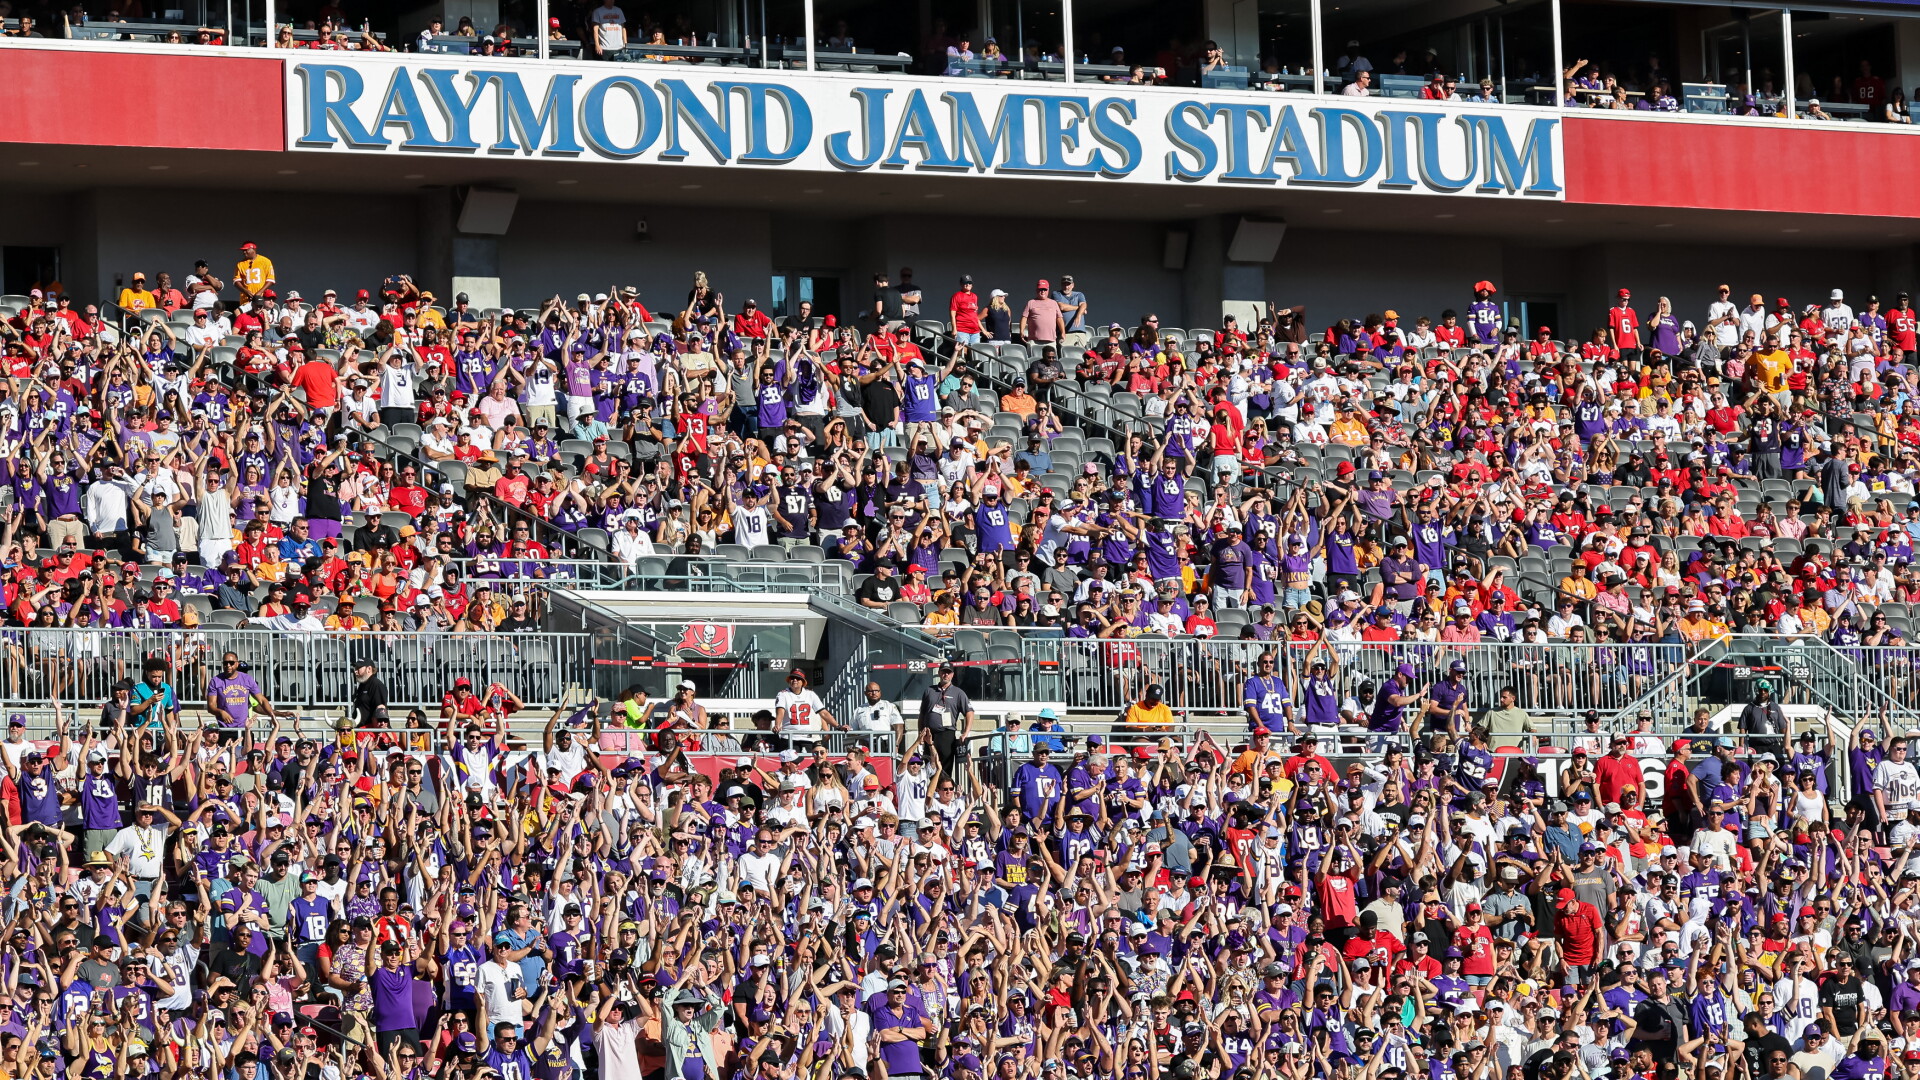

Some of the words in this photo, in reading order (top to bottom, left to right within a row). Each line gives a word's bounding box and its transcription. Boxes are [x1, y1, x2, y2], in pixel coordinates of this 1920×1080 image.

[1859, 87, 1875, 99] 82
[294, 63, 813, 164] RAYMOND
[824, 87, 1142, 178] JAMES
[1165, 101, 1563, 195] STADIUM
[246, 268, 261, 284] 13
[1478, 310, 1495, 324] 94
[1622, 318, 1632, 334] 6
[1896, 319, 1916, 332] 55
[535, 369, 550, 384] 19
[627, 380, 645, 394] 43
[915, 384, 930, 401] 18
[687, 418, 704, 436] 13
[1791, 432, 1800, 449] 9
[950, 472, 959, 481] 61
[786, 496, 806, 514] 87
[747, 516, 762, 533] 18
[988, 509, 1004, 527] 19
[1421, 529, 1438, 544] 18
[770, 659, 788, 668] 237
[909, 661, 926, 669] 236
[1735, 667, 1751, 675] 236
[1794, 668, 1809, 676] 235
[1262, 693, 1282, 714] 43
[790, 704, 811, 725] 12
[31, 778, 48, 801] 3
[92, 780, 114, 798] 33
[146, 785, 164, 806] 18
[914, 779, 927, 800] 18
[1889, 780, 1917, 802] MOS
[1298, 828, 1320, 851] 19
[306, 916, 326, 940] 18
[1707, 1003, 1724, 1026] 18
[1797, 997, 1813, 1020] 18
[1225, 1037, 1253, 1056] 84
[1388, 1047, 1408, 1072] 18
